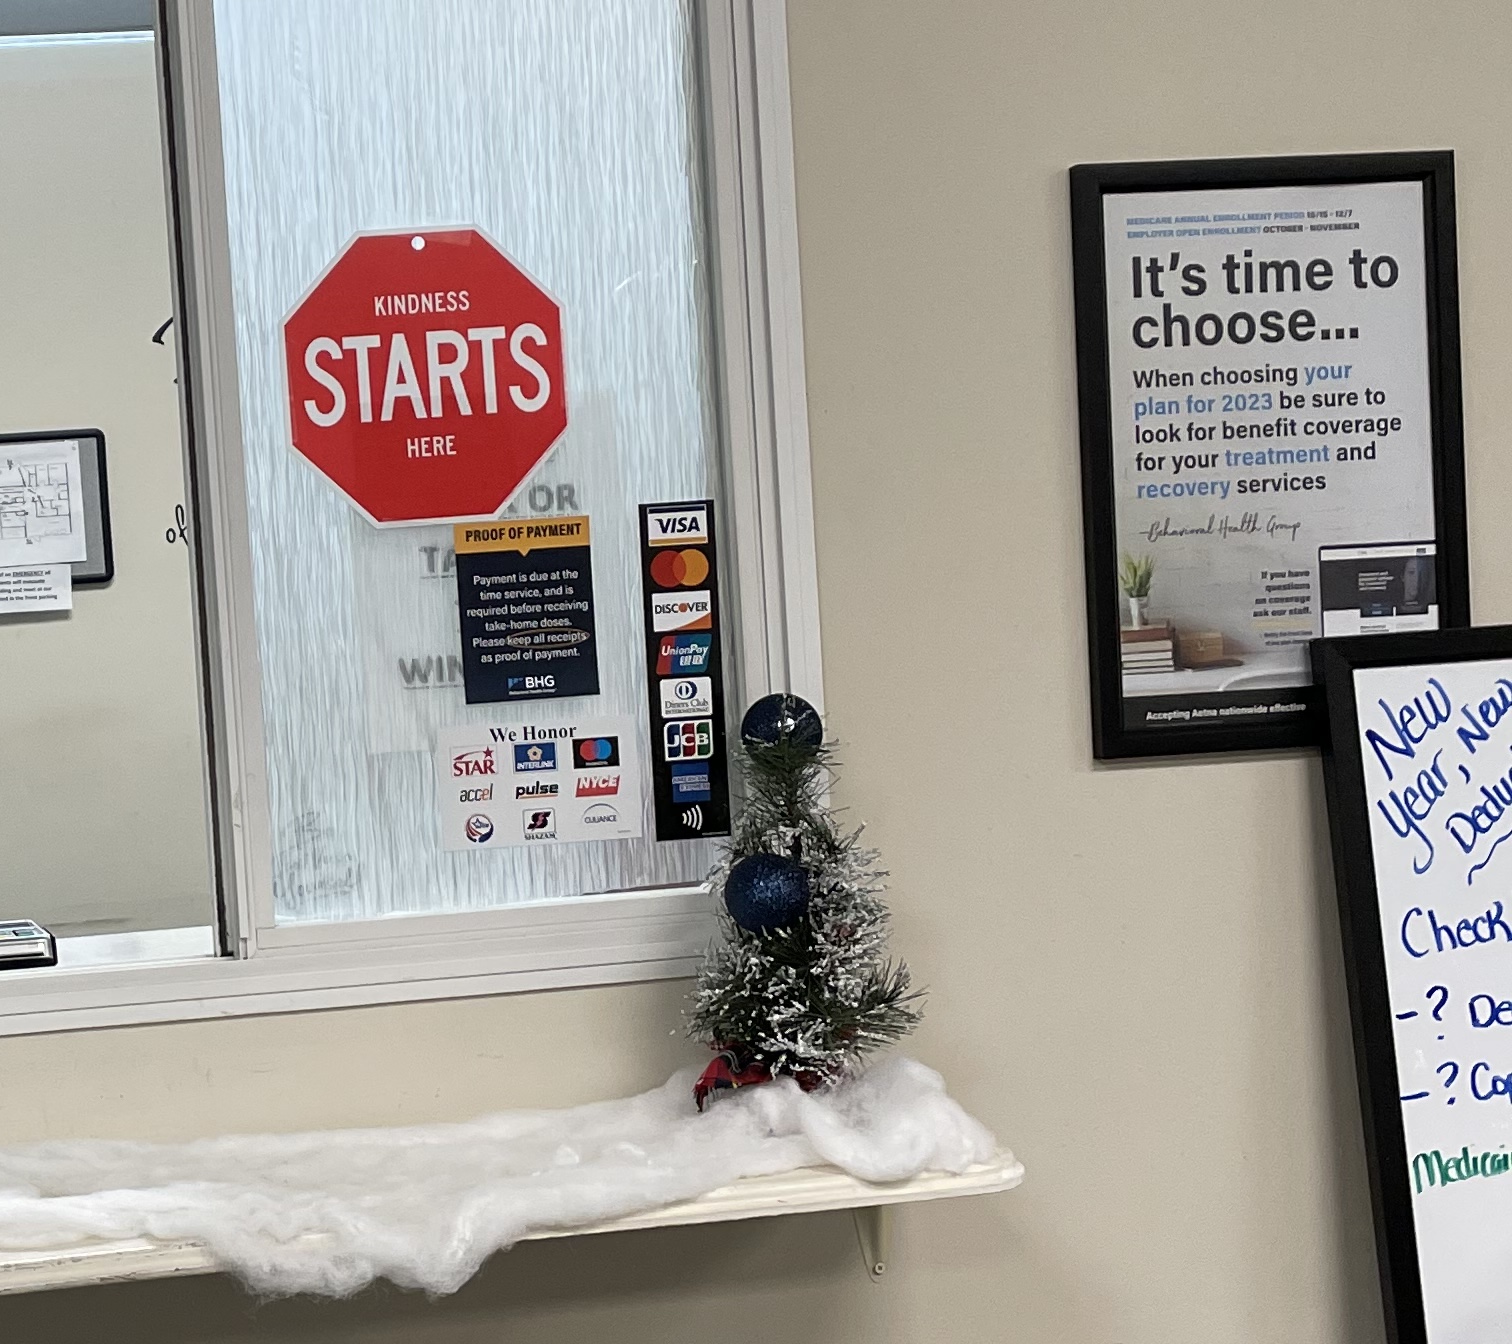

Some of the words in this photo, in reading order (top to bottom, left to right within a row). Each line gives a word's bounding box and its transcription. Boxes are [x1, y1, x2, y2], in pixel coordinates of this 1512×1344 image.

[1133, 252, 1206, 298] It’s
[1222, 250, 1333, 294] time
[1349, 249, 1398, 288] to
[375, 291, 469, 316] KINDNESS
[1133, 303, 1358, 348] choose...
[304, 323, 550, 426] STARTS
[1133, 369, 1193, 388] When
[1201, 364, 1297, 386] choosing
[1304, 365, 1352, 386] your
[1135, 397, 1179, 421] plan
[1186, 395, 1215, 413] for
[1222, 393, 1272, 412] 2023
[1280, 391, 1305, 409] be
[1313, 392, 1358, 407] sure
[1365, 388, 1385, 405] to
[1136, 424, 1181, 444] look
[1187, 422, 1216, 441] for
[1223, 418, 1296, 439] benefit
[1304, 418, 1401, 436] coverage
[407, 436, 456, 458] HERE
[1136, 452, 1165, 471] for
[1172, 454, 1218, 474] your
[1225, 445, 1330, 466] treatment
[1337, 441, 1375, 461] and
[1137, 481, 1230, 499] recovery
[1238, 473, 1326, 493] services
[529, 483, 578, 513] OR
[466, 528, 505, 542] PROOF
[509, 527, 524, 539] OF
[527, 523, 581, 538] PAYMENT
[655, 517, 700, 533] VISA
[473, 574, 516, 587] Payment
[519, 572, 527, 582] is
[529, 572, 548, 581] due
[551, 571, 560, 580] at
[562, 569, 578, 579] the
[480, 592, 502, 600] time
[504, 587, 542, 599] service,
[544, 586, 563, 596] and
[565, 585, 574, 594] is
[467, 604, 508, 618] required
[510, 603, 541, 614] before
[544, 600, 588, 611] receiving
[655, 601, 708, 614] DISCOVER
[485, 620, 538, 632] take-home
[540, 618, 572, 627] doses.
[473, 637, 505, 647] Please
[507, 636, 531, 646] keep
[534, 634, 545, 643] all
[548, 632, 587, 643] receipts
[495, 650, 520, 664] proof
[523, 650, 532, 660] of
[535, 648, 580, 661] payment.
[661, 644, 708, 659] UnionPay
[526, 675, 554, 688] BHG
[690, 698, 708, 706] Club
[1457, 679, 1512, 754] New
[490, 728, 516, 742] We
[523, 726, 576, 740] Honor
[1365, 678, 1451, 781] New
[667, 733, 708, 747] JCB
[453, 760, 495, 777] STAR
[516, 781, 559, 799] pulse
[579, 775, 618, 789] NYCE
[460, 783, 493, 803] accel
[1445, 768, 1512, 853] Dedu
[1401, 901, 1512, 958] Check
